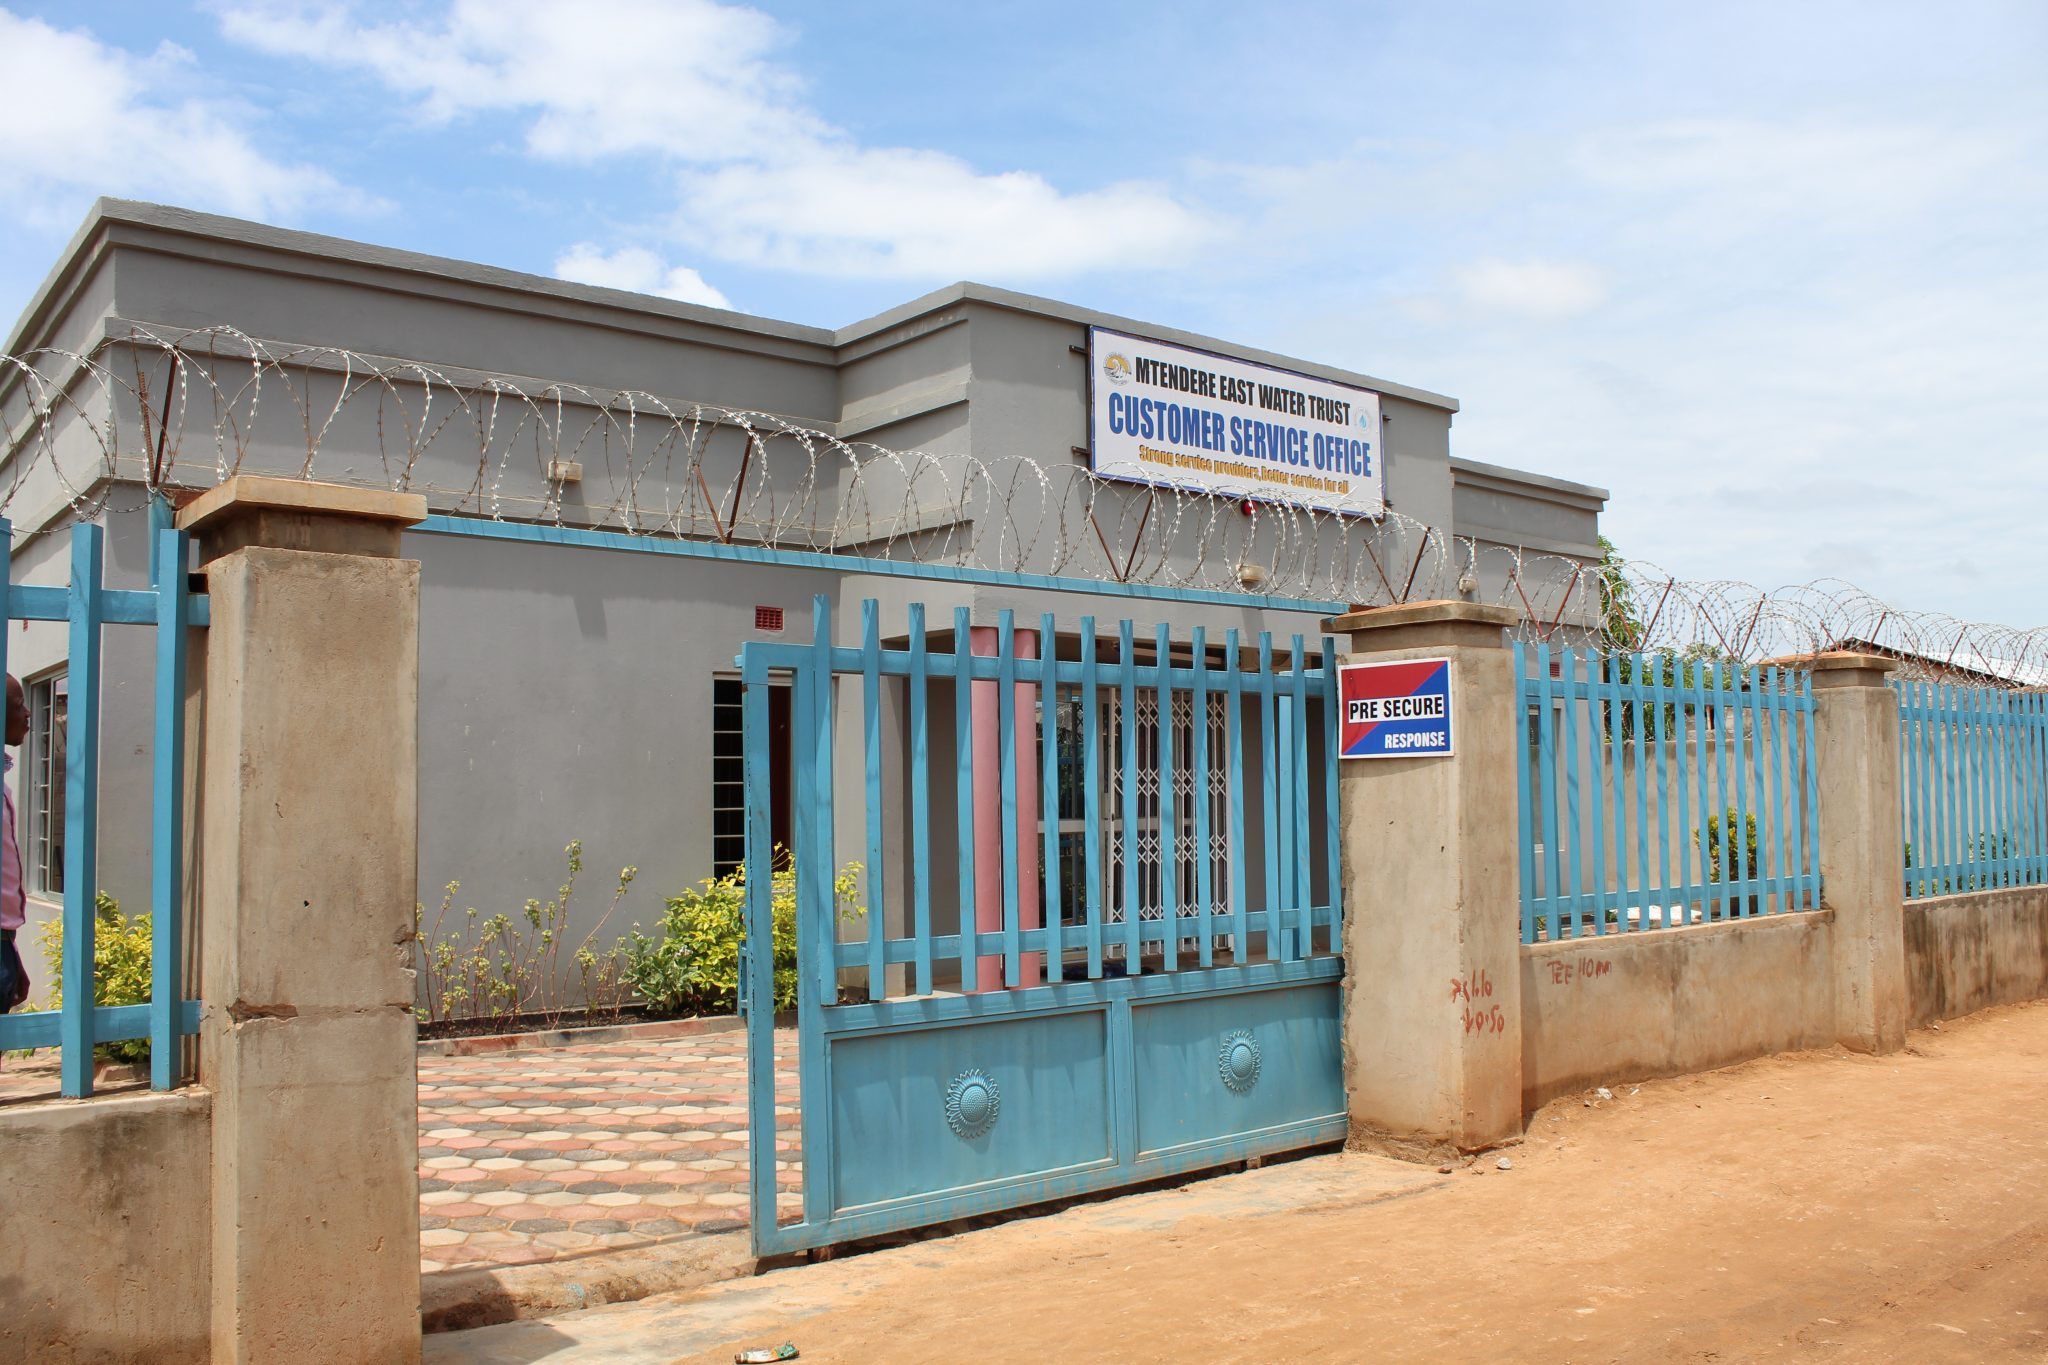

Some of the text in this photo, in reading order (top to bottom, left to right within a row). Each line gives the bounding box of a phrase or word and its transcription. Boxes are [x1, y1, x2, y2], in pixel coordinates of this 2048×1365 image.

[1135, 356, 1216, 398] MTENDERE
[1220, 375, 1255, 404] EAST
[1258, 383, 1305, 416] WATER
[1308, 395, 1350, 425] TRUST
[1108, 392, 1372, 477] CUSTOMER SERVICE OFFICE
[1139, 445, 1173, 467] Strong
[1175, 453, 1212, 472] service
[1290, 473, 1323, 490] service
[1324, 476, 1336, 493] for
[1338, 480, 1349, 494] all
[1350, 696, 1443, 720] PRE SECURE
[1384, 731, 1446, 749] RESPONSE
